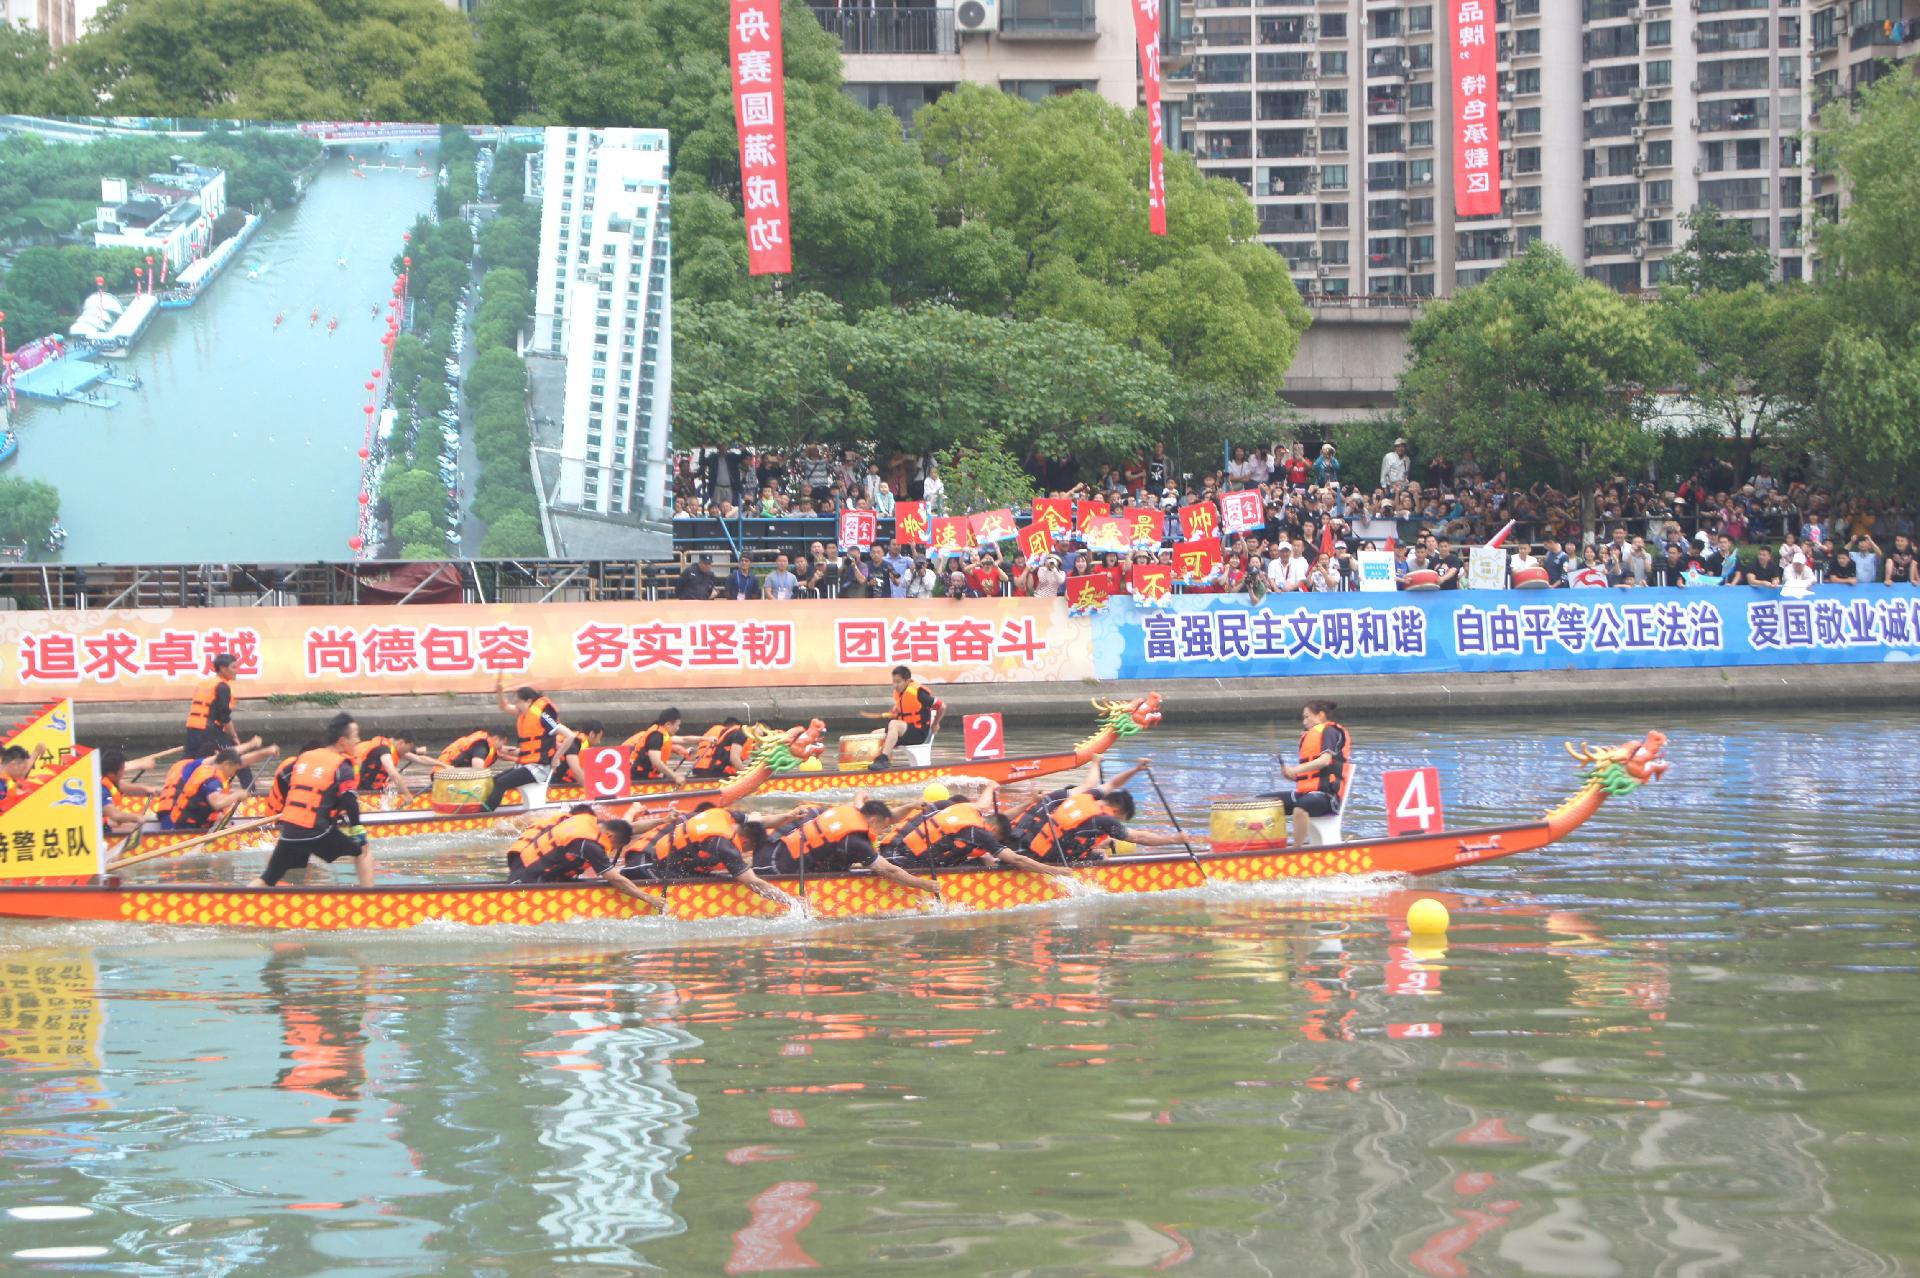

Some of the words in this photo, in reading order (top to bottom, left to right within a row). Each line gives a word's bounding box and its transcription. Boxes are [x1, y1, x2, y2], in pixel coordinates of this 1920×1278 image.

[933, 521, 962, 551] 速
[1129, 515, 1156, 545] 最
[1188, 507, 1212, 538] 帅
[1028, 530, 1050, 557] 团
[1179, 551, 1209, 577] 可
[1143, 572, 1166, 600] 不
[1144, 608, 1424, 660] 富强民主文明和谐
[1456, 605, 1720, 652] 自由平等公正法治
[20, 631, 259, 681] 追求卓越
[307, 626, 532, 675] 尚德包容
[577, 622, 793, 669] 务实坚韧
[837, 619, 1046, 664] 团结奋斗
[971, 715, 1000, 758] 2
[594, 748, 626, 796] 3
[1394, 770, 1436, 829] 4
